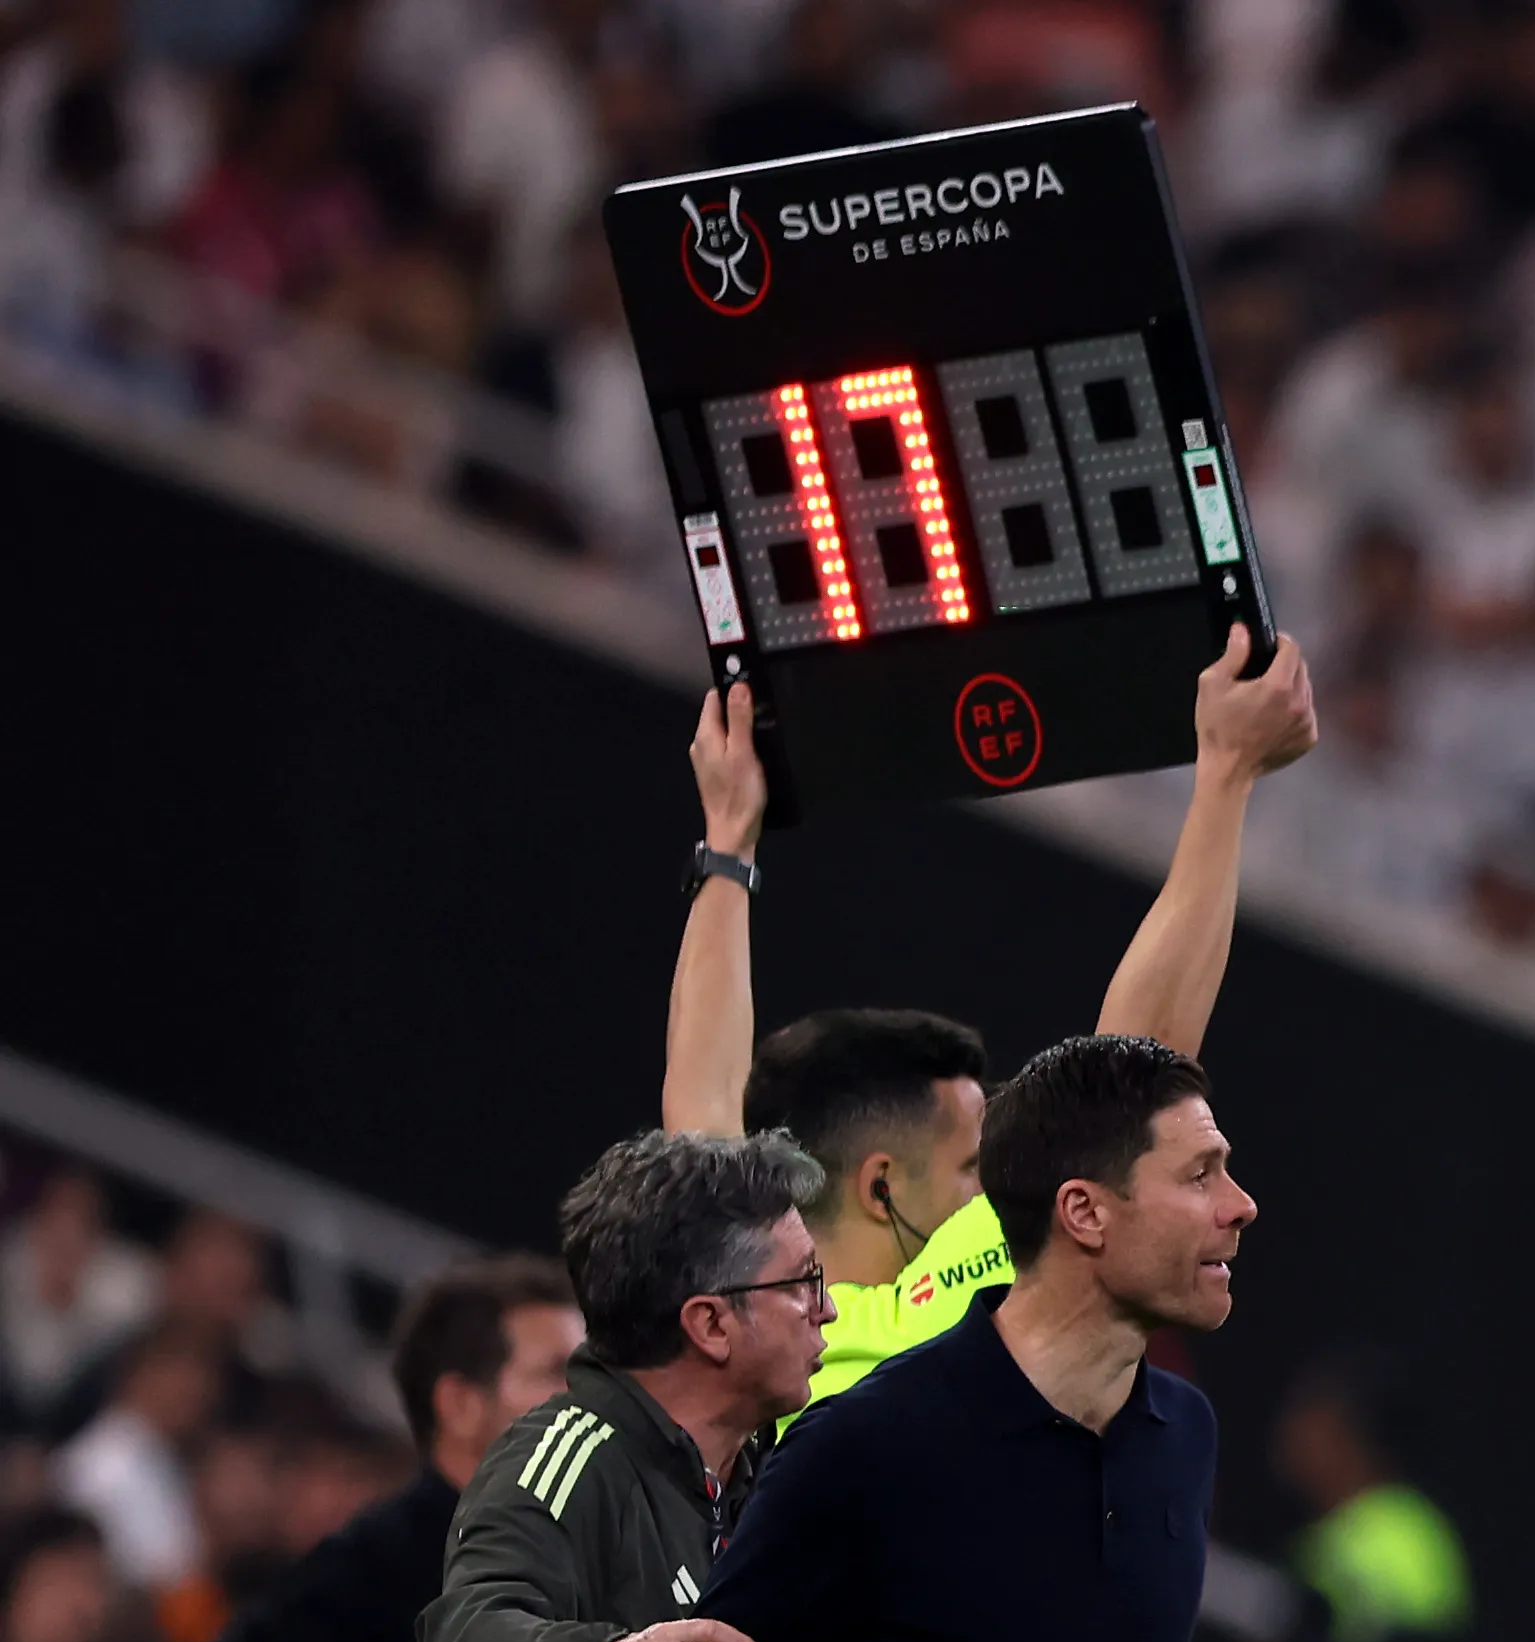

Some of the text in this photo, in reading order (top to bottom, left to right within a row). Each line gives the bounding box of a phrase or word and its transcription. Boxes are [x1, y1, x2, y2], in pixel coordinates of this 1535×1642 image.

[779, 162, 1064, 240] SUPERCOPA
[852, 216, 1010, 264] DE ESPAÑA
[778, 366, 969, 639] 17
[972, 699, 1015, 727] RF
[980, 730, 1022, 759] EF
